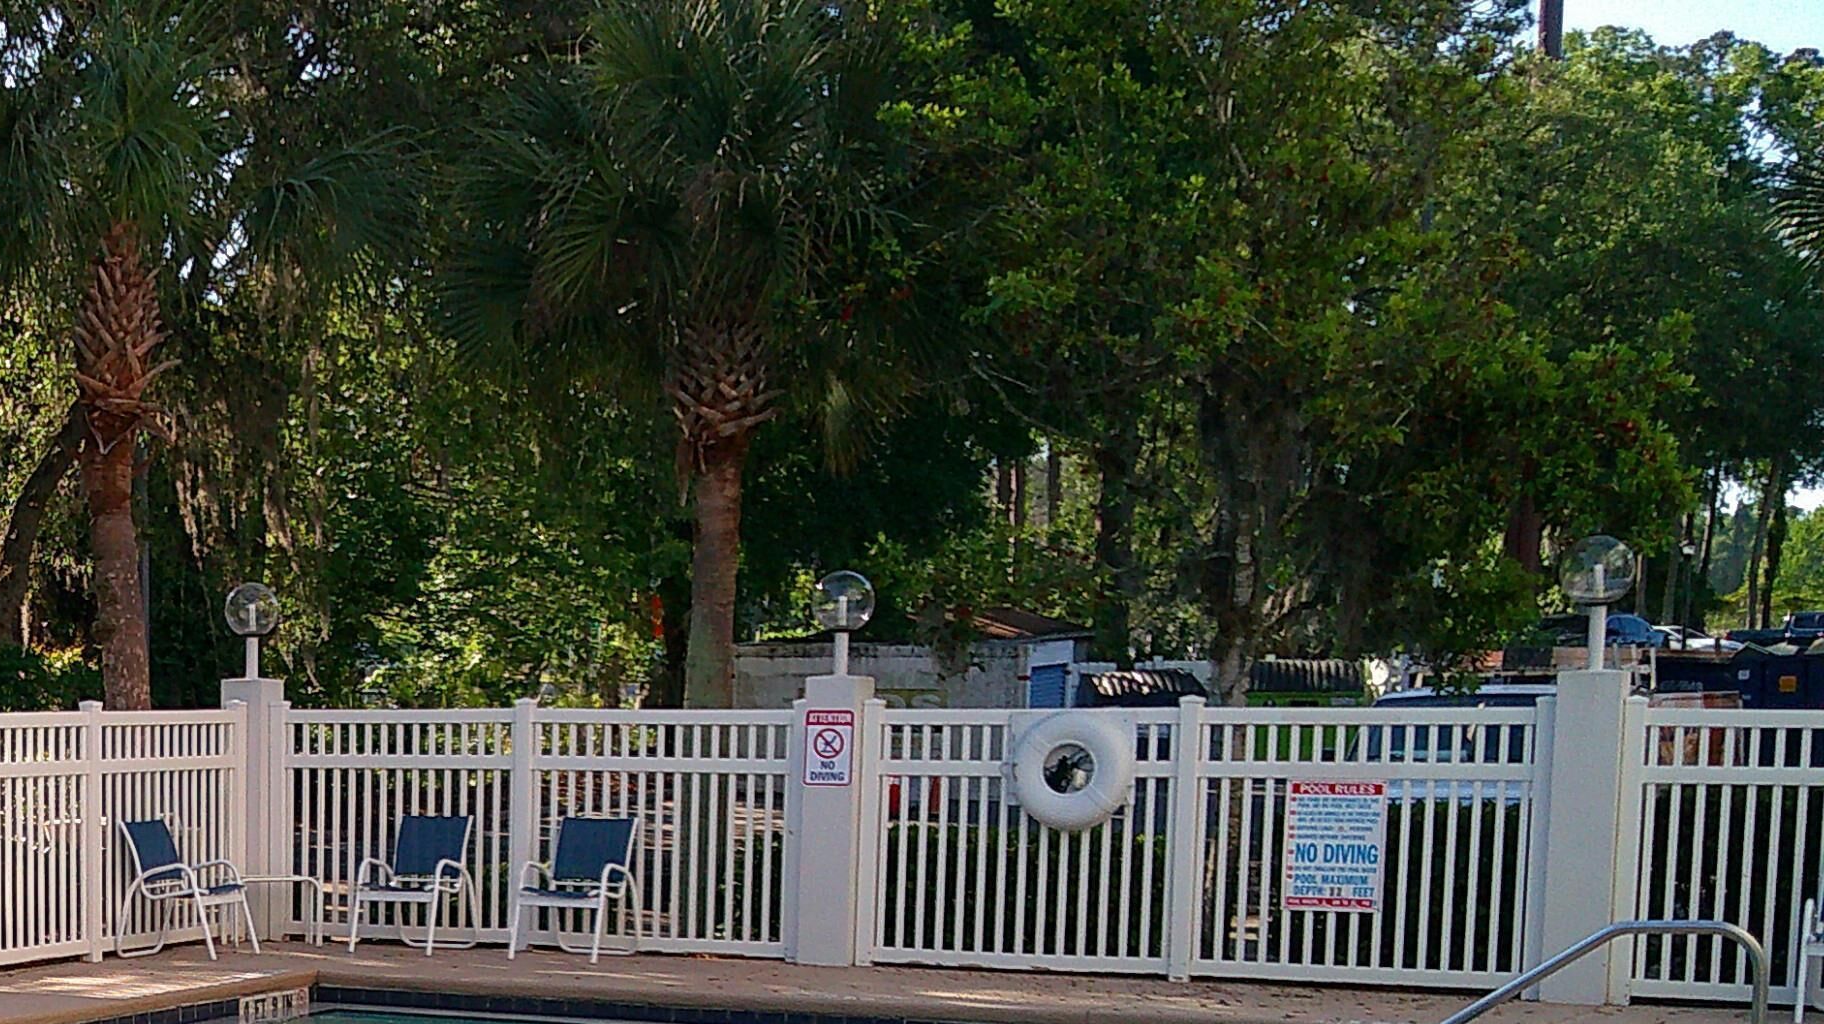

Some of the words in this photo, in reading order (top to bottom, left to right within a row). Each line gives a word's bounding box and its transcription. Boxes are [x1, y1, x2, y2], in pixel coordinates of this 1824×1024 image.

[820, 760, 836, 770] NO
[810, 771, 845, 781] DIVING
[1299, 784, 1330, 794] POOL
[1335, 784, 1376, 794] RULES
[1296, 843, 1318, 863] NO
[1323, 843, 1379, 865] DIVING
[1353, 887, 1375, 897] FEET
